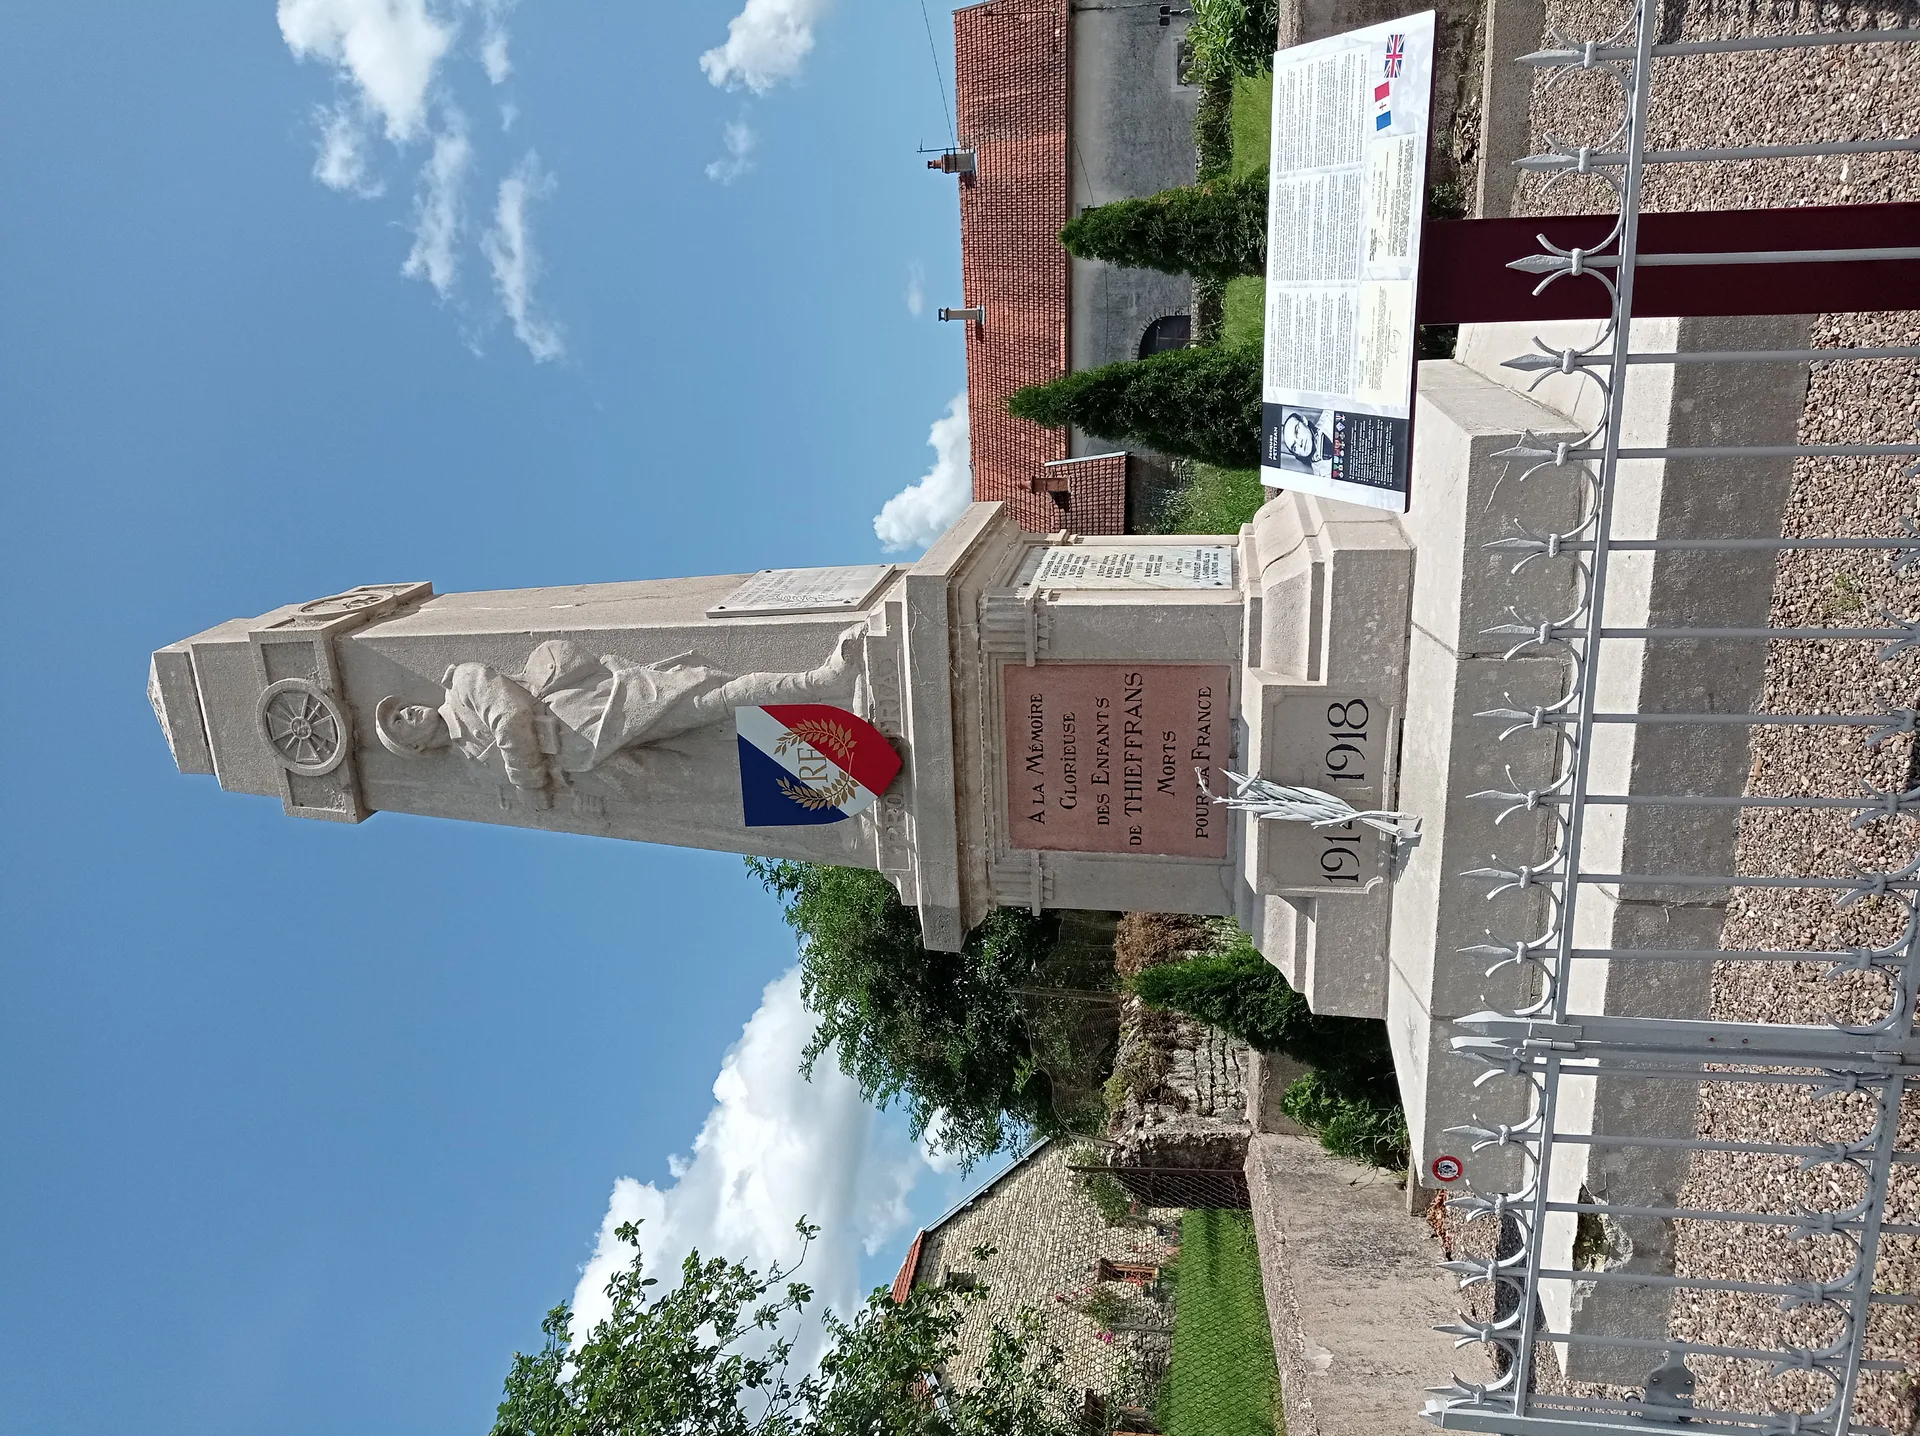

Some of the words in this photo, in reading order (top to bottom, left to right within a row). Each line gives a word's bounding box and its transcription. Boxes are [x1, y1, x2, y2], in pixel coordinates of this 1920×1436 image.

[1025, 693, 1044, 776] MÉMOIRE
[1091, 696, 1110, 786] ENFANTS
[1124, 672, 1144, 818] THIEFFRANS
[1191, 686, 1212, 762] FRANCE
[1324, 698, 1369, 782] 1918
[797, 746, 828, 783] RF
[1031, 783, 1044, 804] LA
[1059, 712, 1078, 810] GLORIEUSE
[1157, 730, 1176, 797] MORTS
[1027, 810, 1045, 825] A
[1096, 793, 1110, 826] DES
[1129, 825, 1142, 846] DE
[1195, 794, 1209, 839] POUR
